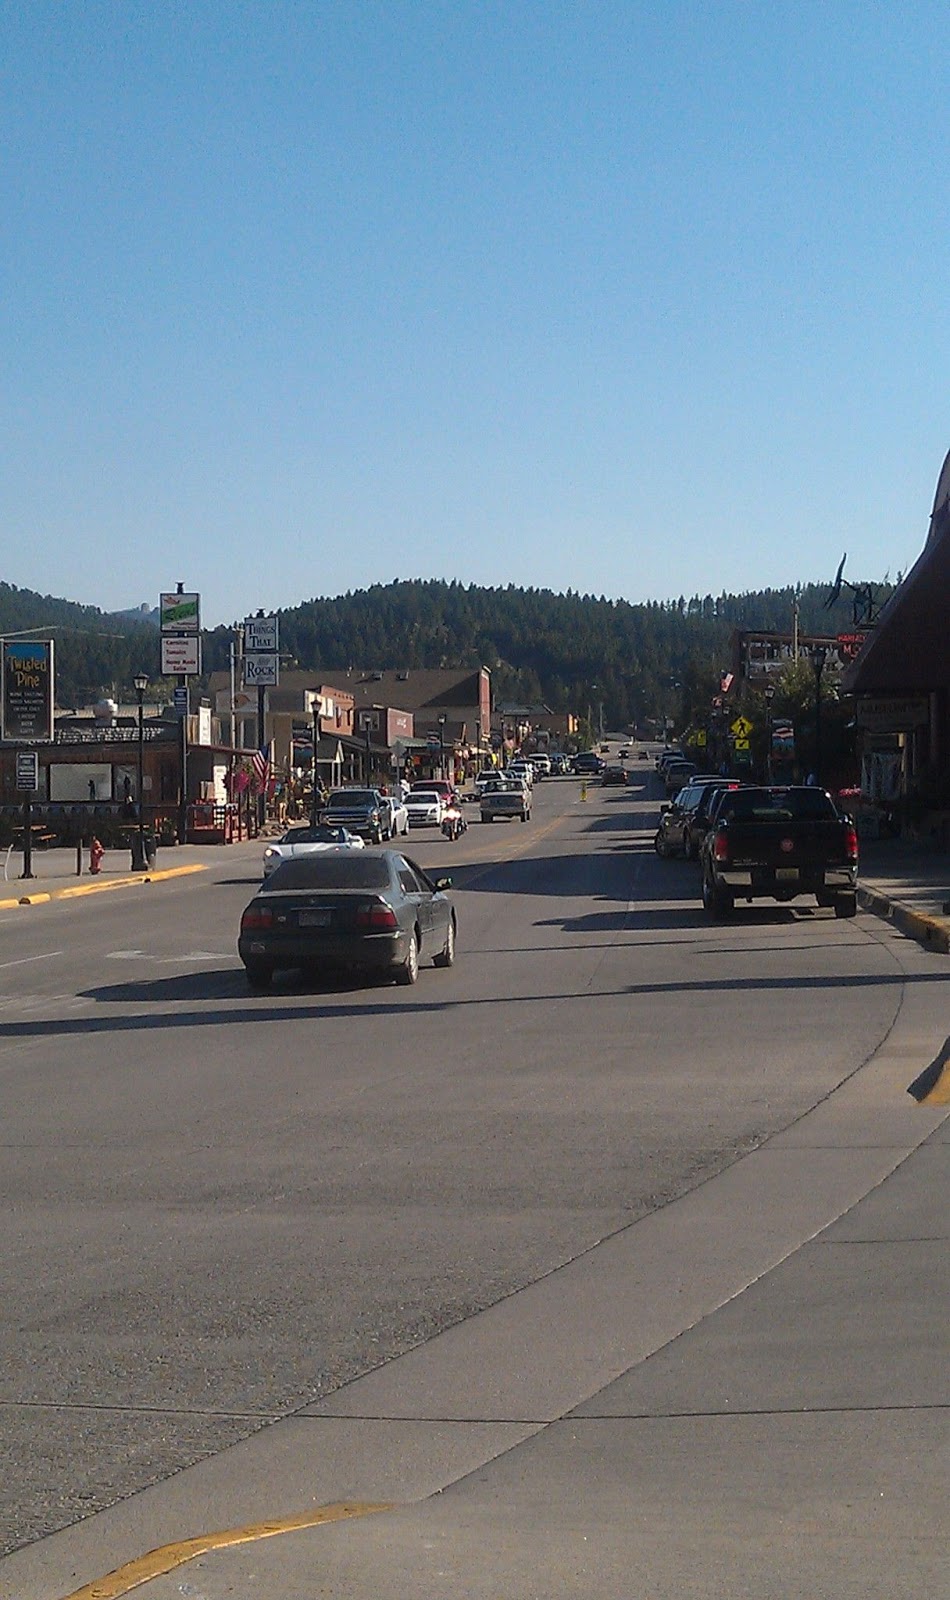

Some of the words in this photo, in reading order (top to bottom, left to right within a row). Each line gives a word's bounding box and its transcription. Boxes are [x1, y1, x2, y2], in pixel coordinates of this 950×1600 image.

[246, 624, 275, 635] THINGS
[250, 636, 272, 647] THAT
[8, 656, 47, 672] Twisted
[247, 661, 275, 677] ROCK
[15, 671, 40, 688] Pine
